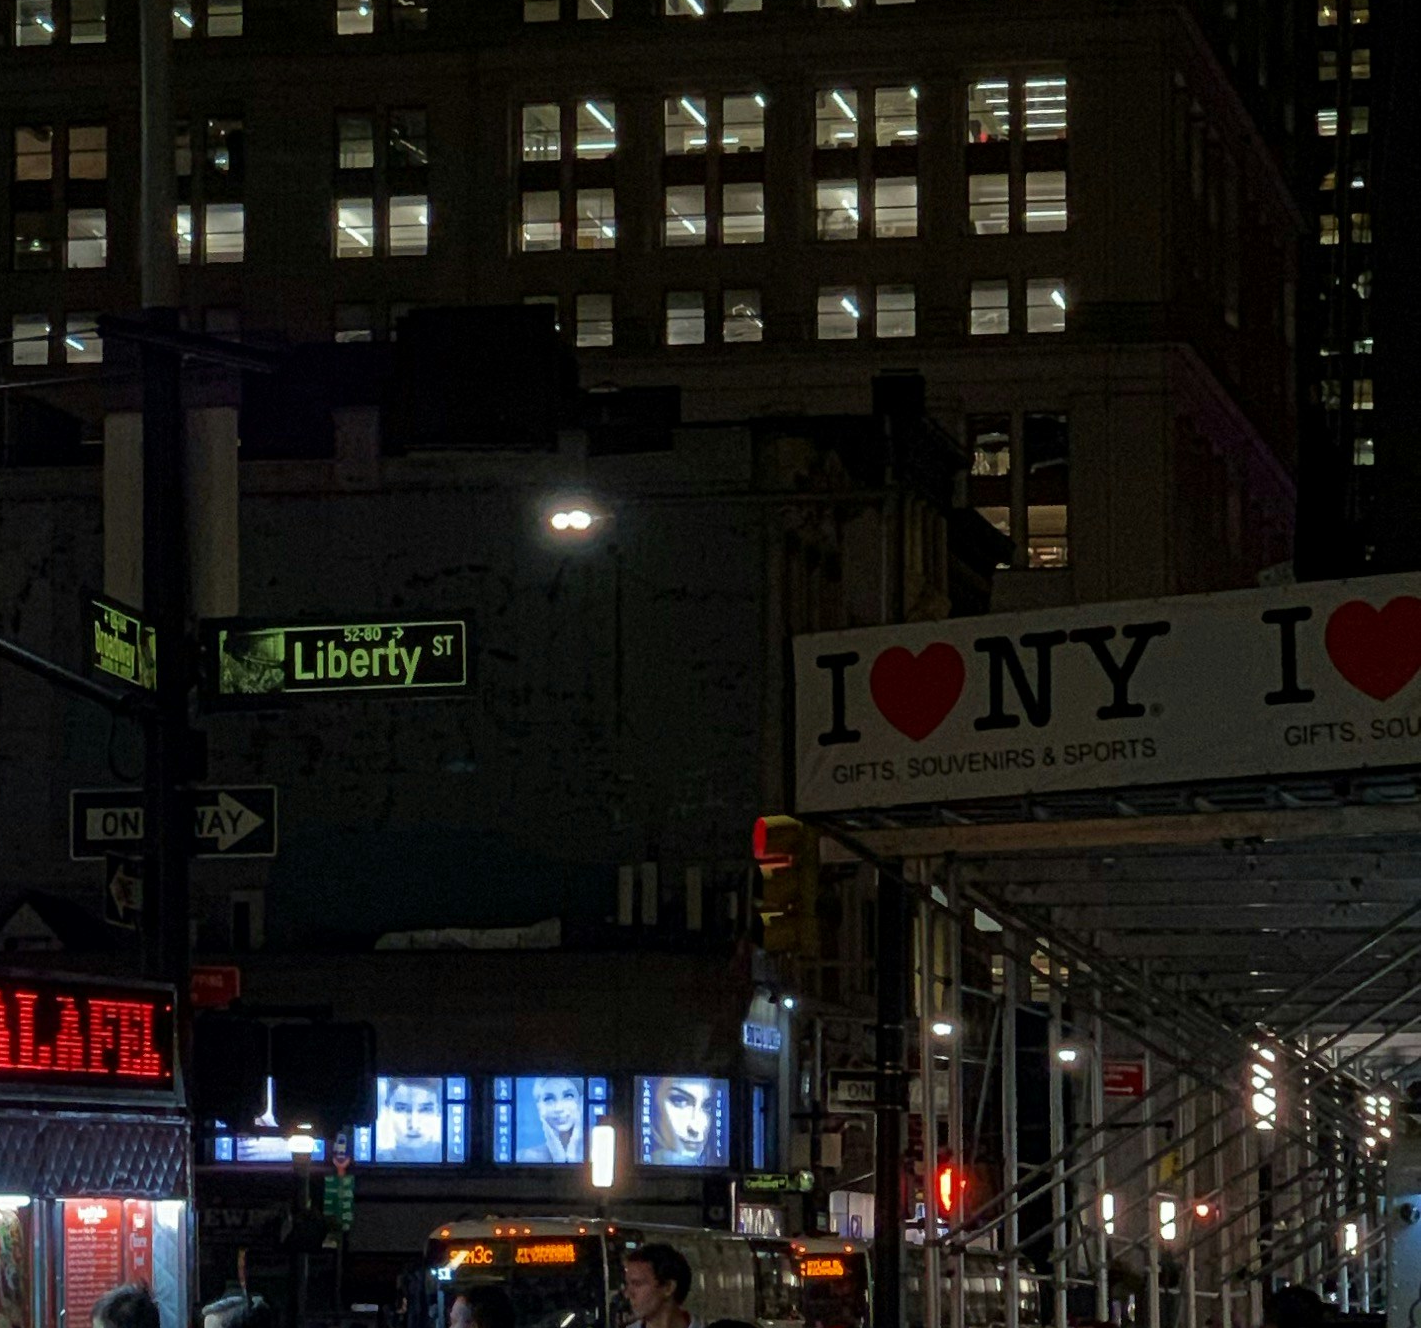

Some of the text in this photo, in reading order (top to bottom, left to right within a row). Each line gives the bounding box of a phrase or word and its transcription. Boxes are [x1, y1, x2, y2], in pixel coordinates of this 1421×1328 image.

[344, 627, 382, 642] 52-80
[1260, 605, 1316, 706] I
[294, 634, 455, 685] Liberty ST
[816, 619, 1172, 747] I NY
[1284, 721, 1363, 748] GIFTS,
[833, 737, 1157, 786] GIFTS, SOUVENIRS & SPORTS
[102, 811, 139, 836] ON
